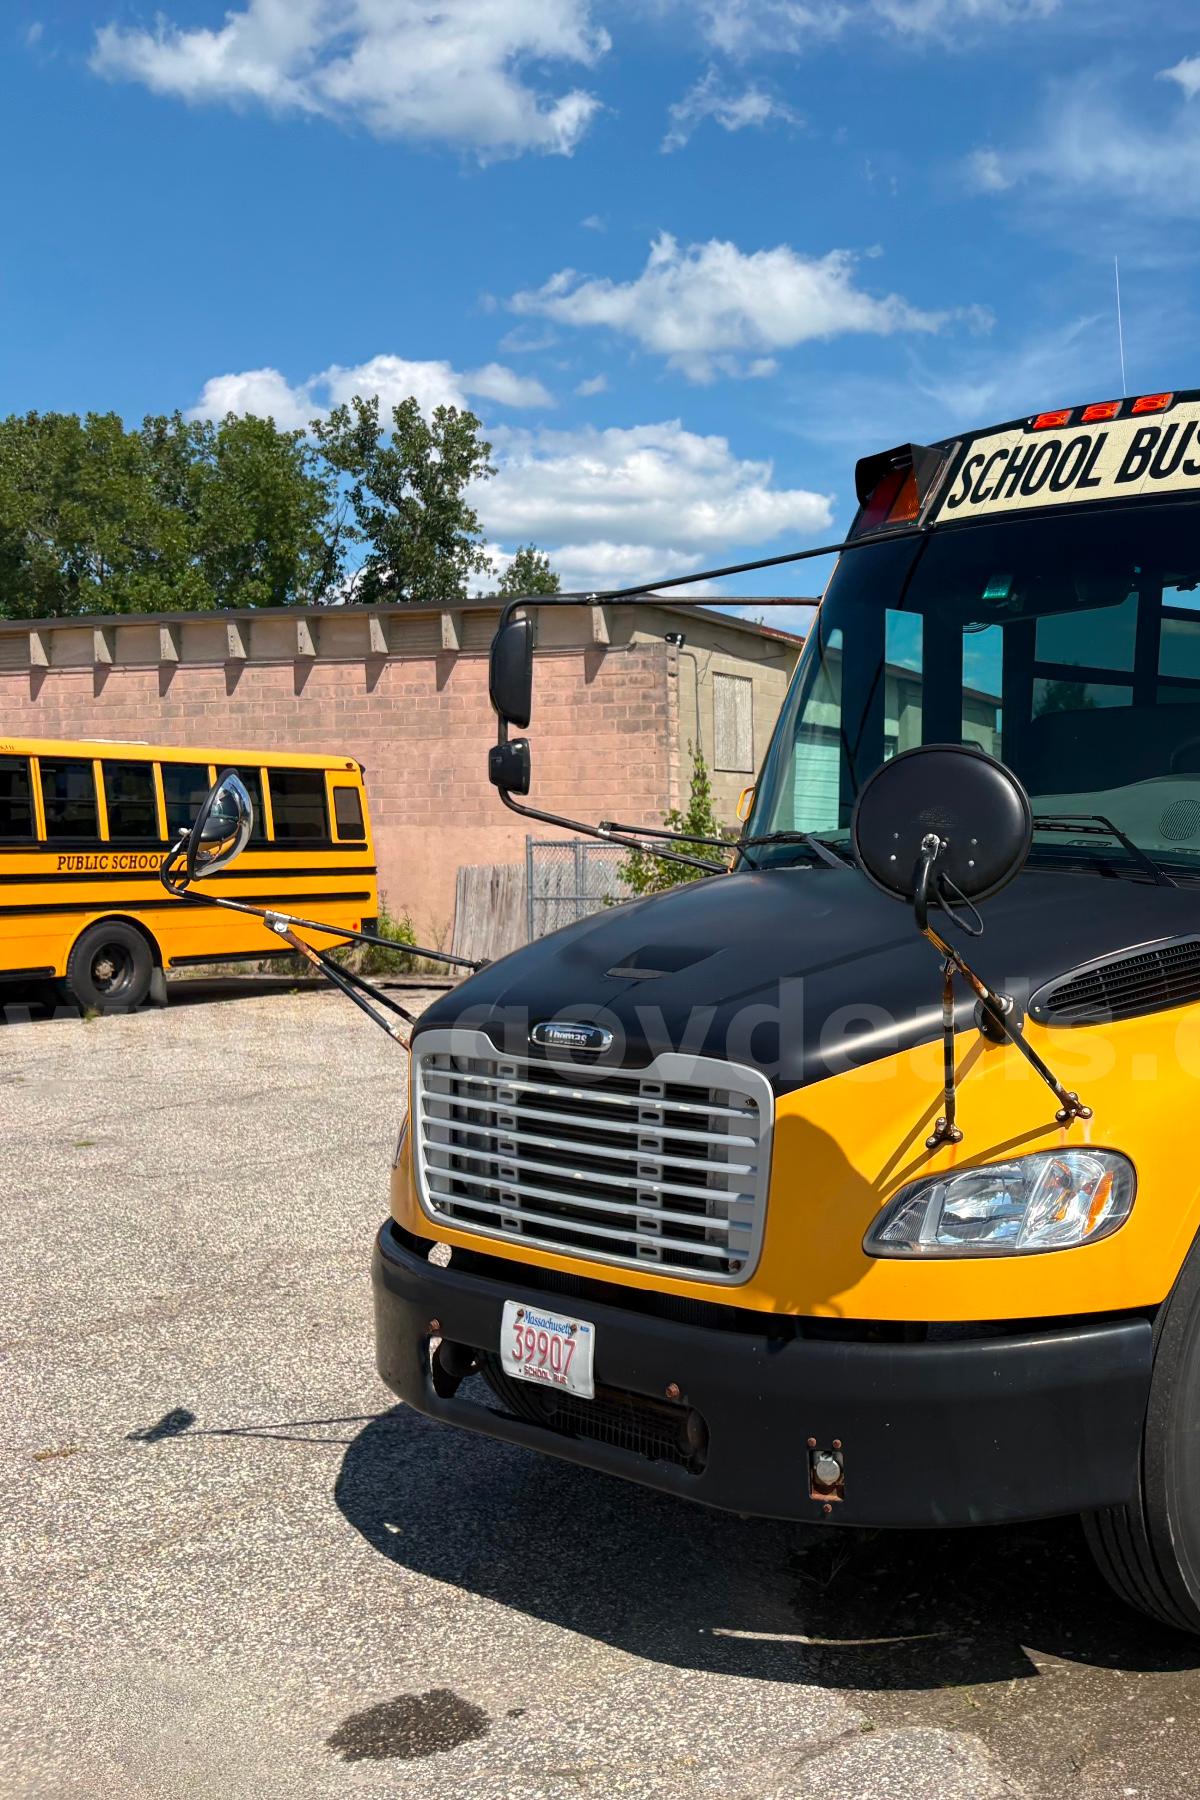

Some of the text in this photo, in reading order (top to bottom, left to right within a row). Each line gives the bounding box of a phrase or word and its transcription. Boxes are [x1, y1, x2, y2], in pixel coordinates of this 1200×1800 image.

[948, 432, 1109, 509] SCHOOL
[57, 855, 109, 871] PUBLIC
[547, 1028, 588, 1043] Thomas
[512, 1323, 576, 1377] 39907
[523, 1364, 568, 1385] SCHOOL BUS
